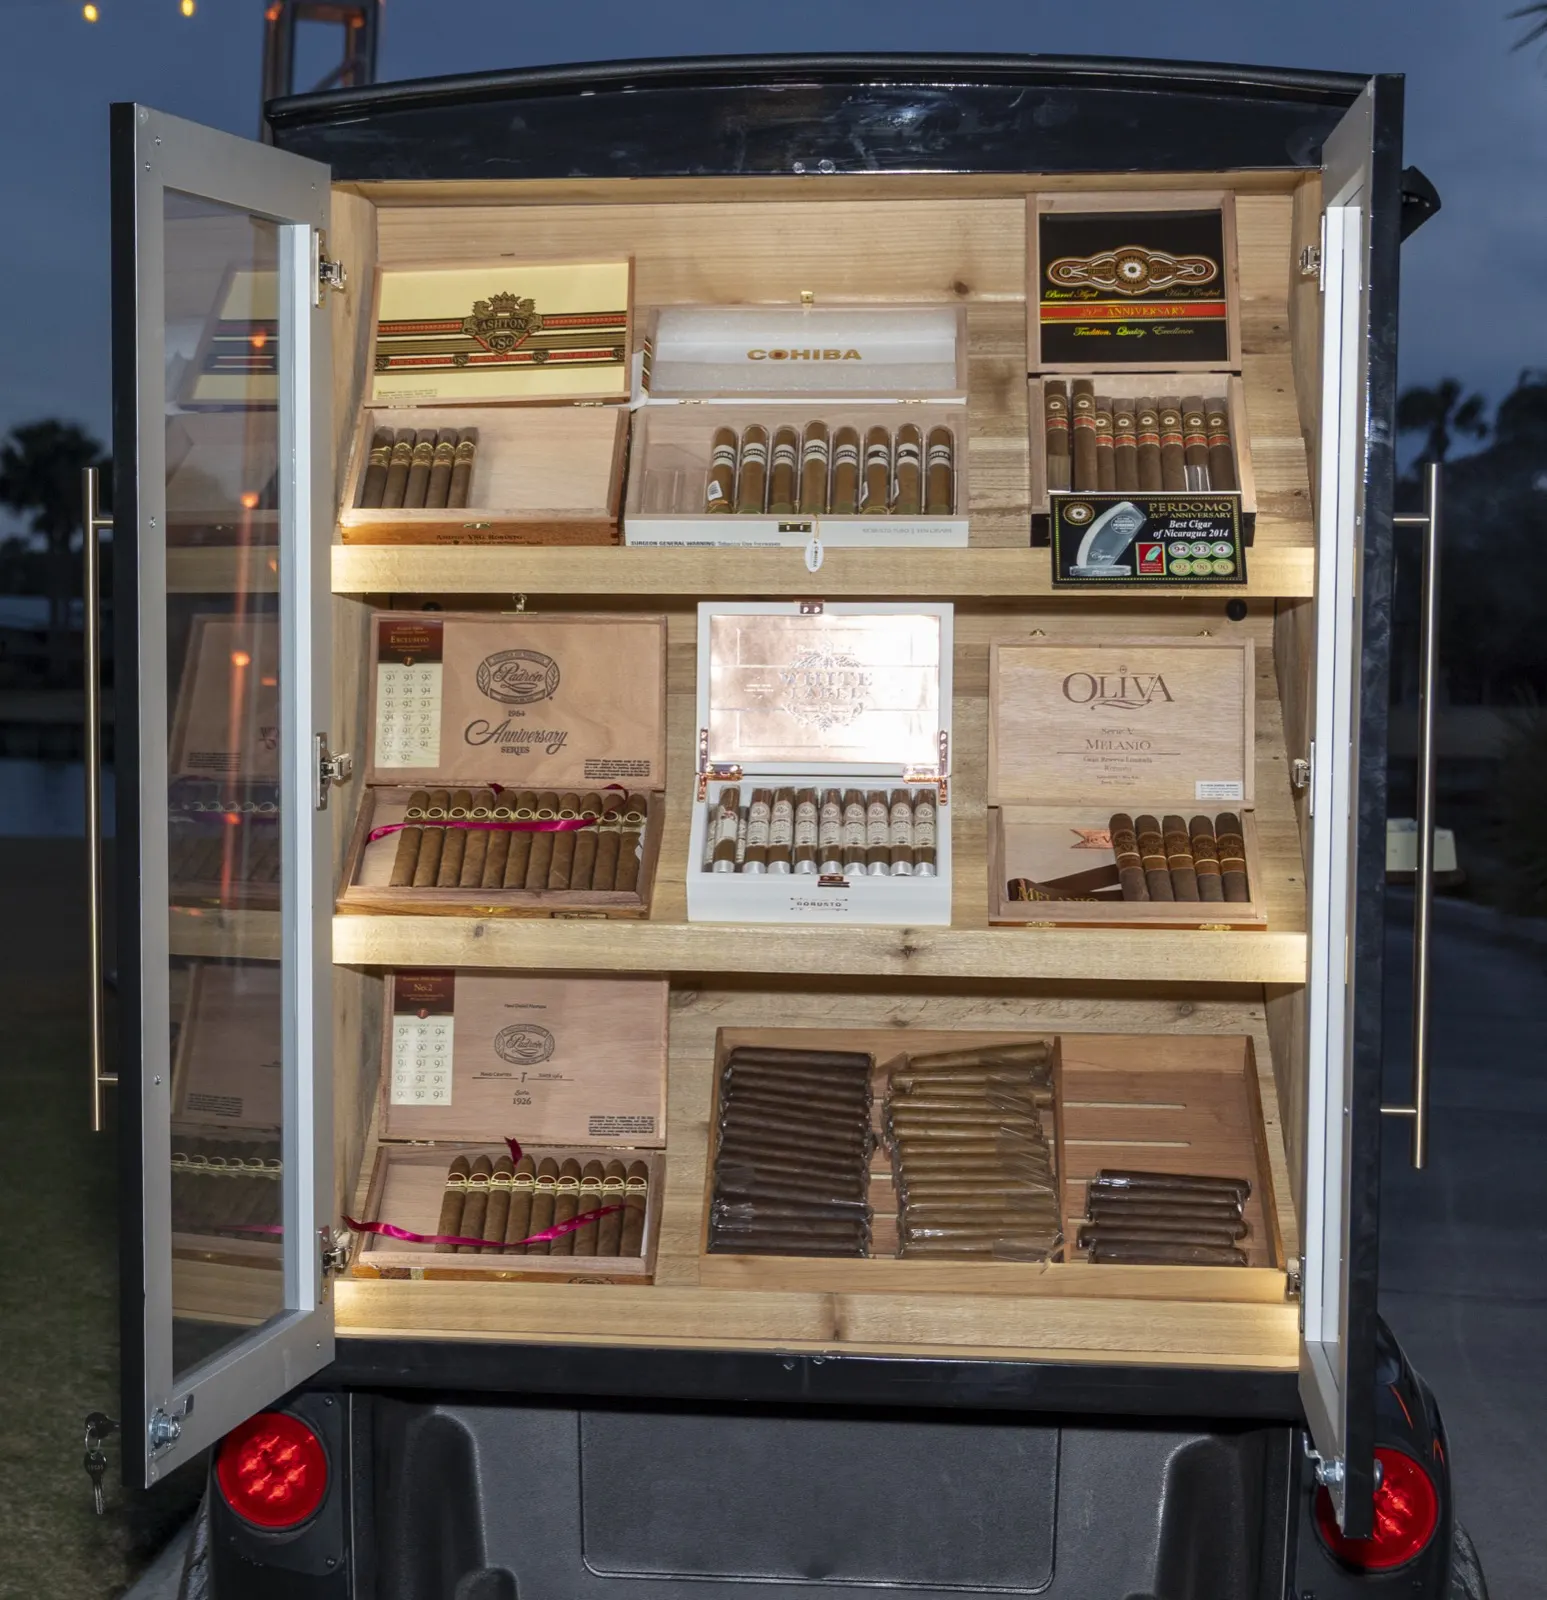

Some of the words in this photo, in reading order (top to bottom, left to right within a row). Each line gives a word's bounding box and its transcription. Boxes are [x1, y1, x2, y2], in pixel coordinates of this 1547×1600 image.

[1107, 306, 1186, 316] ANNIVERSARY
[480, 319, 526, 331] ASHTON
[491, 336, 513, 347] VSG
[747, 349, 862, 360] COHIBA
[1149, 502, 1231, 512] PERDOMO
[1169, 520, 1187, 528] Best
[1189, 519, 1212, 530] Cigar
[1153, 529, 1163, 539] of
[1163, 529, 1206, 539] Nicaragua
[1208, 529, 1228, 537] 2014
[780, 671, 872, 686] WHITE
[1062, 667, 1175, 708] OLIVA
[464, 719, 568, 755] Anniversary
[1085, 739, 1151, 750] MELANIO
[501, 746, 530, 755] SERIES
